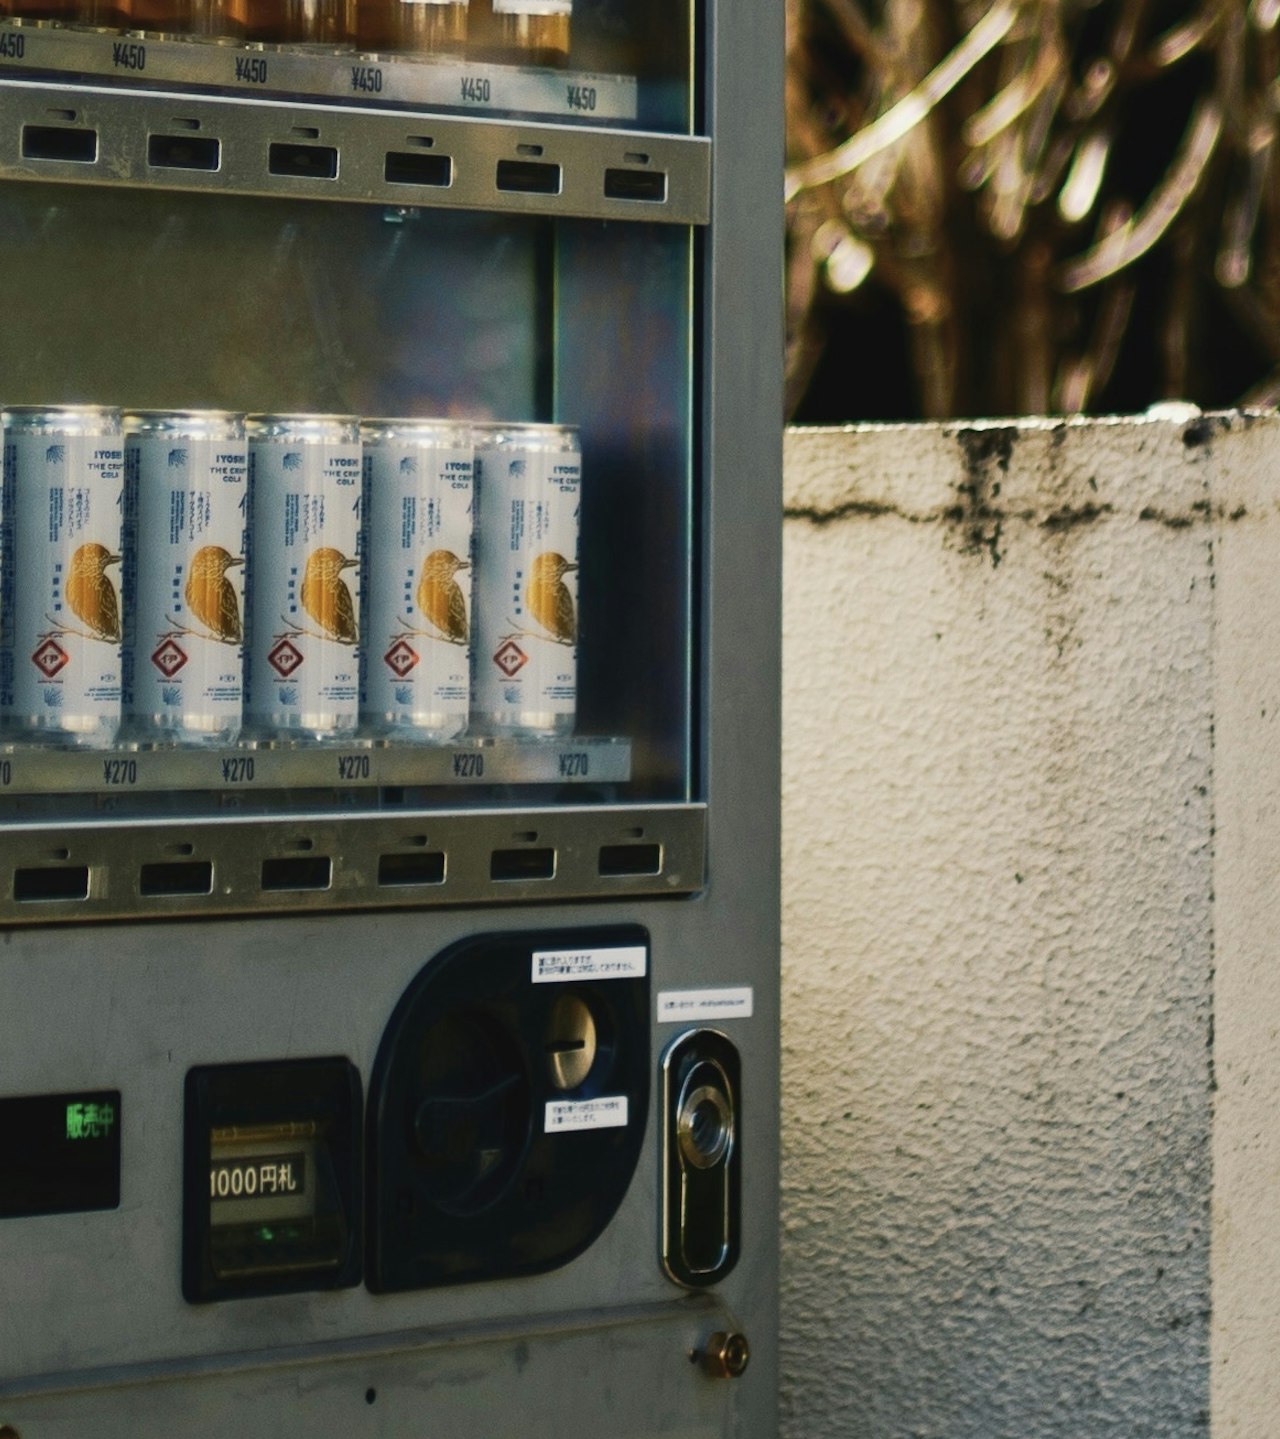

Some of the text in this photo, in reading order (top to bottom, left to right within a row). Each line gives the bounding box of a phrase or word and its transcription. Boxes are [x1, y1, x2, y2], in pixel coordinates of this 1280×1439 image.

[112, 43, 146, 71] ¥450
[235, 56, 267, 84] ¥450
[351, 68, 382, 94] ¥450
[460, 76, 490, 103] ¥450
[567, 85, 596, 112] ¥450
[104, 759, 138, 785] ¥270
[222, 756, 255, 782] ¥270
[339, 754, 370, 780] ¥270
[453, 752, 484, 778] ¥270
[559, 752, 588, 777] ¥270
[65, 1102, 114, 1140] 販売中
[209, 1162, 297, 1198] 1000円札
